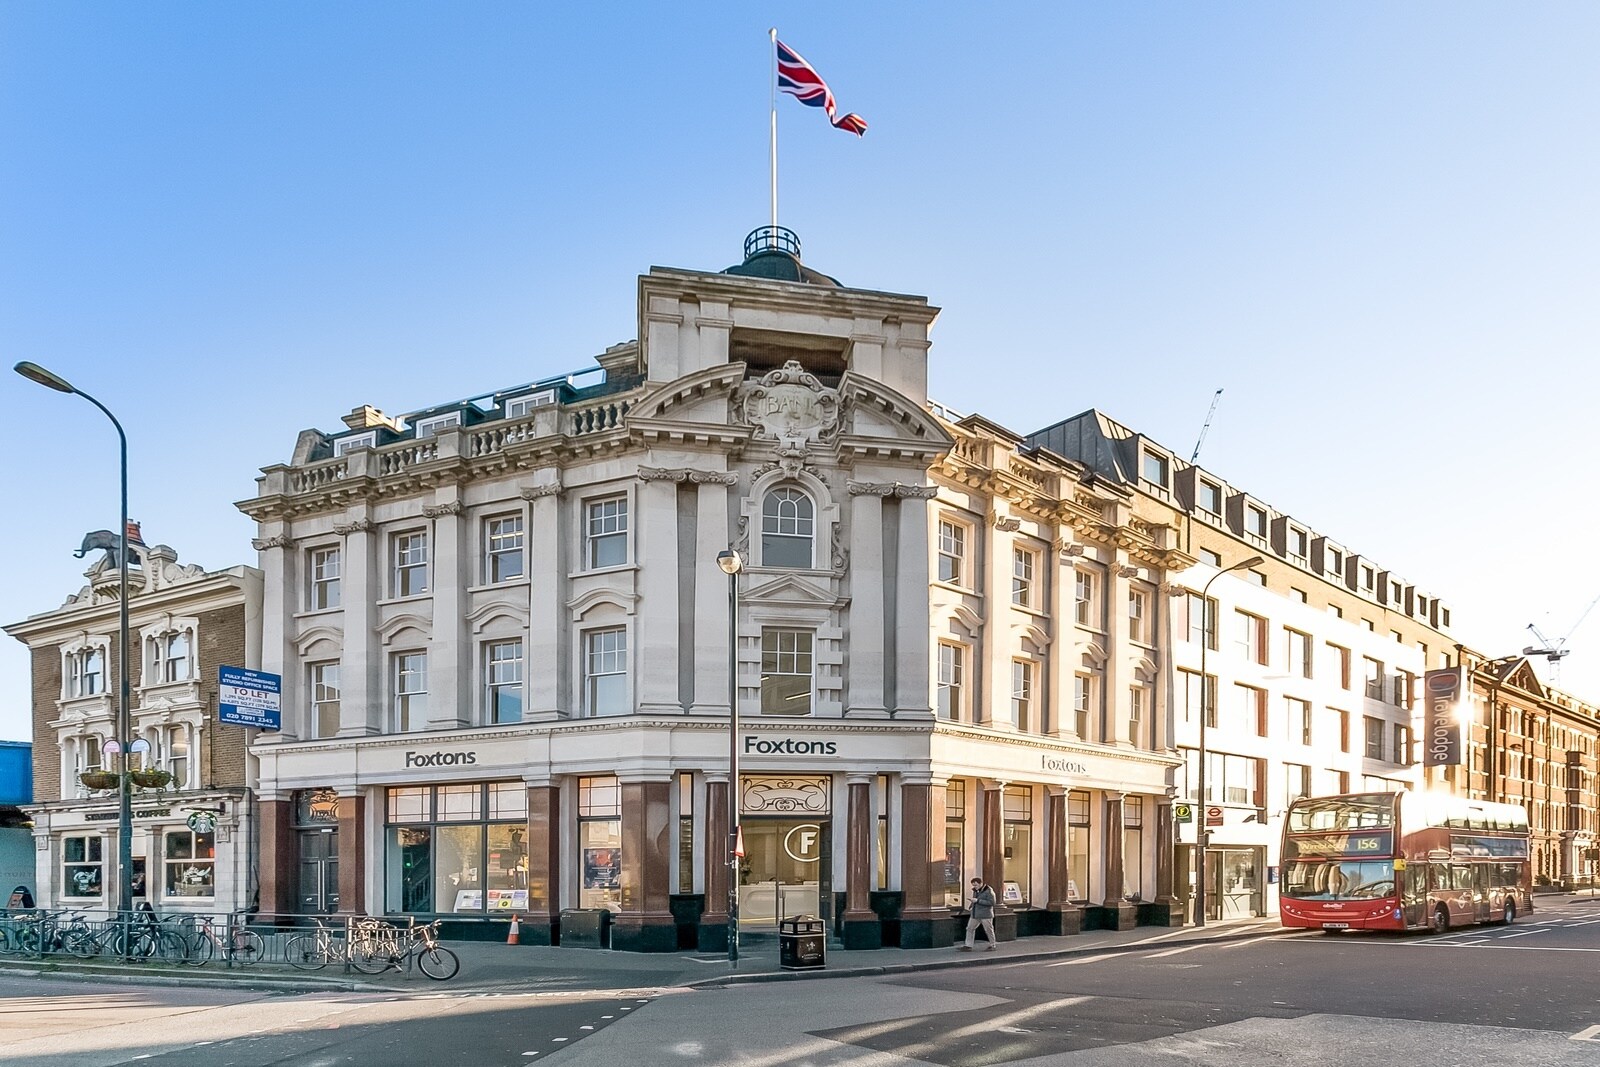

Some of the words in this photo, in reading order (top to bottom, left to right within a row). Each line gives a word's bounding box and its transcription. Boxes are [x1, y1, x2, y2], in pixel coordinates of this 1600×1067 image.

[232, 688, 248, 696] TO
[252, 690, 269, 699] LET
[1429, 691, 1454, 761] Travelodge
[744, 736, 837, 754] Foxtons
[406, 751, 476, 768] Foxtons
[136, 809, 171, 818] COFFEE
[800, 832, 817, 854] F
[1358, 838, 1378, 850] 156
